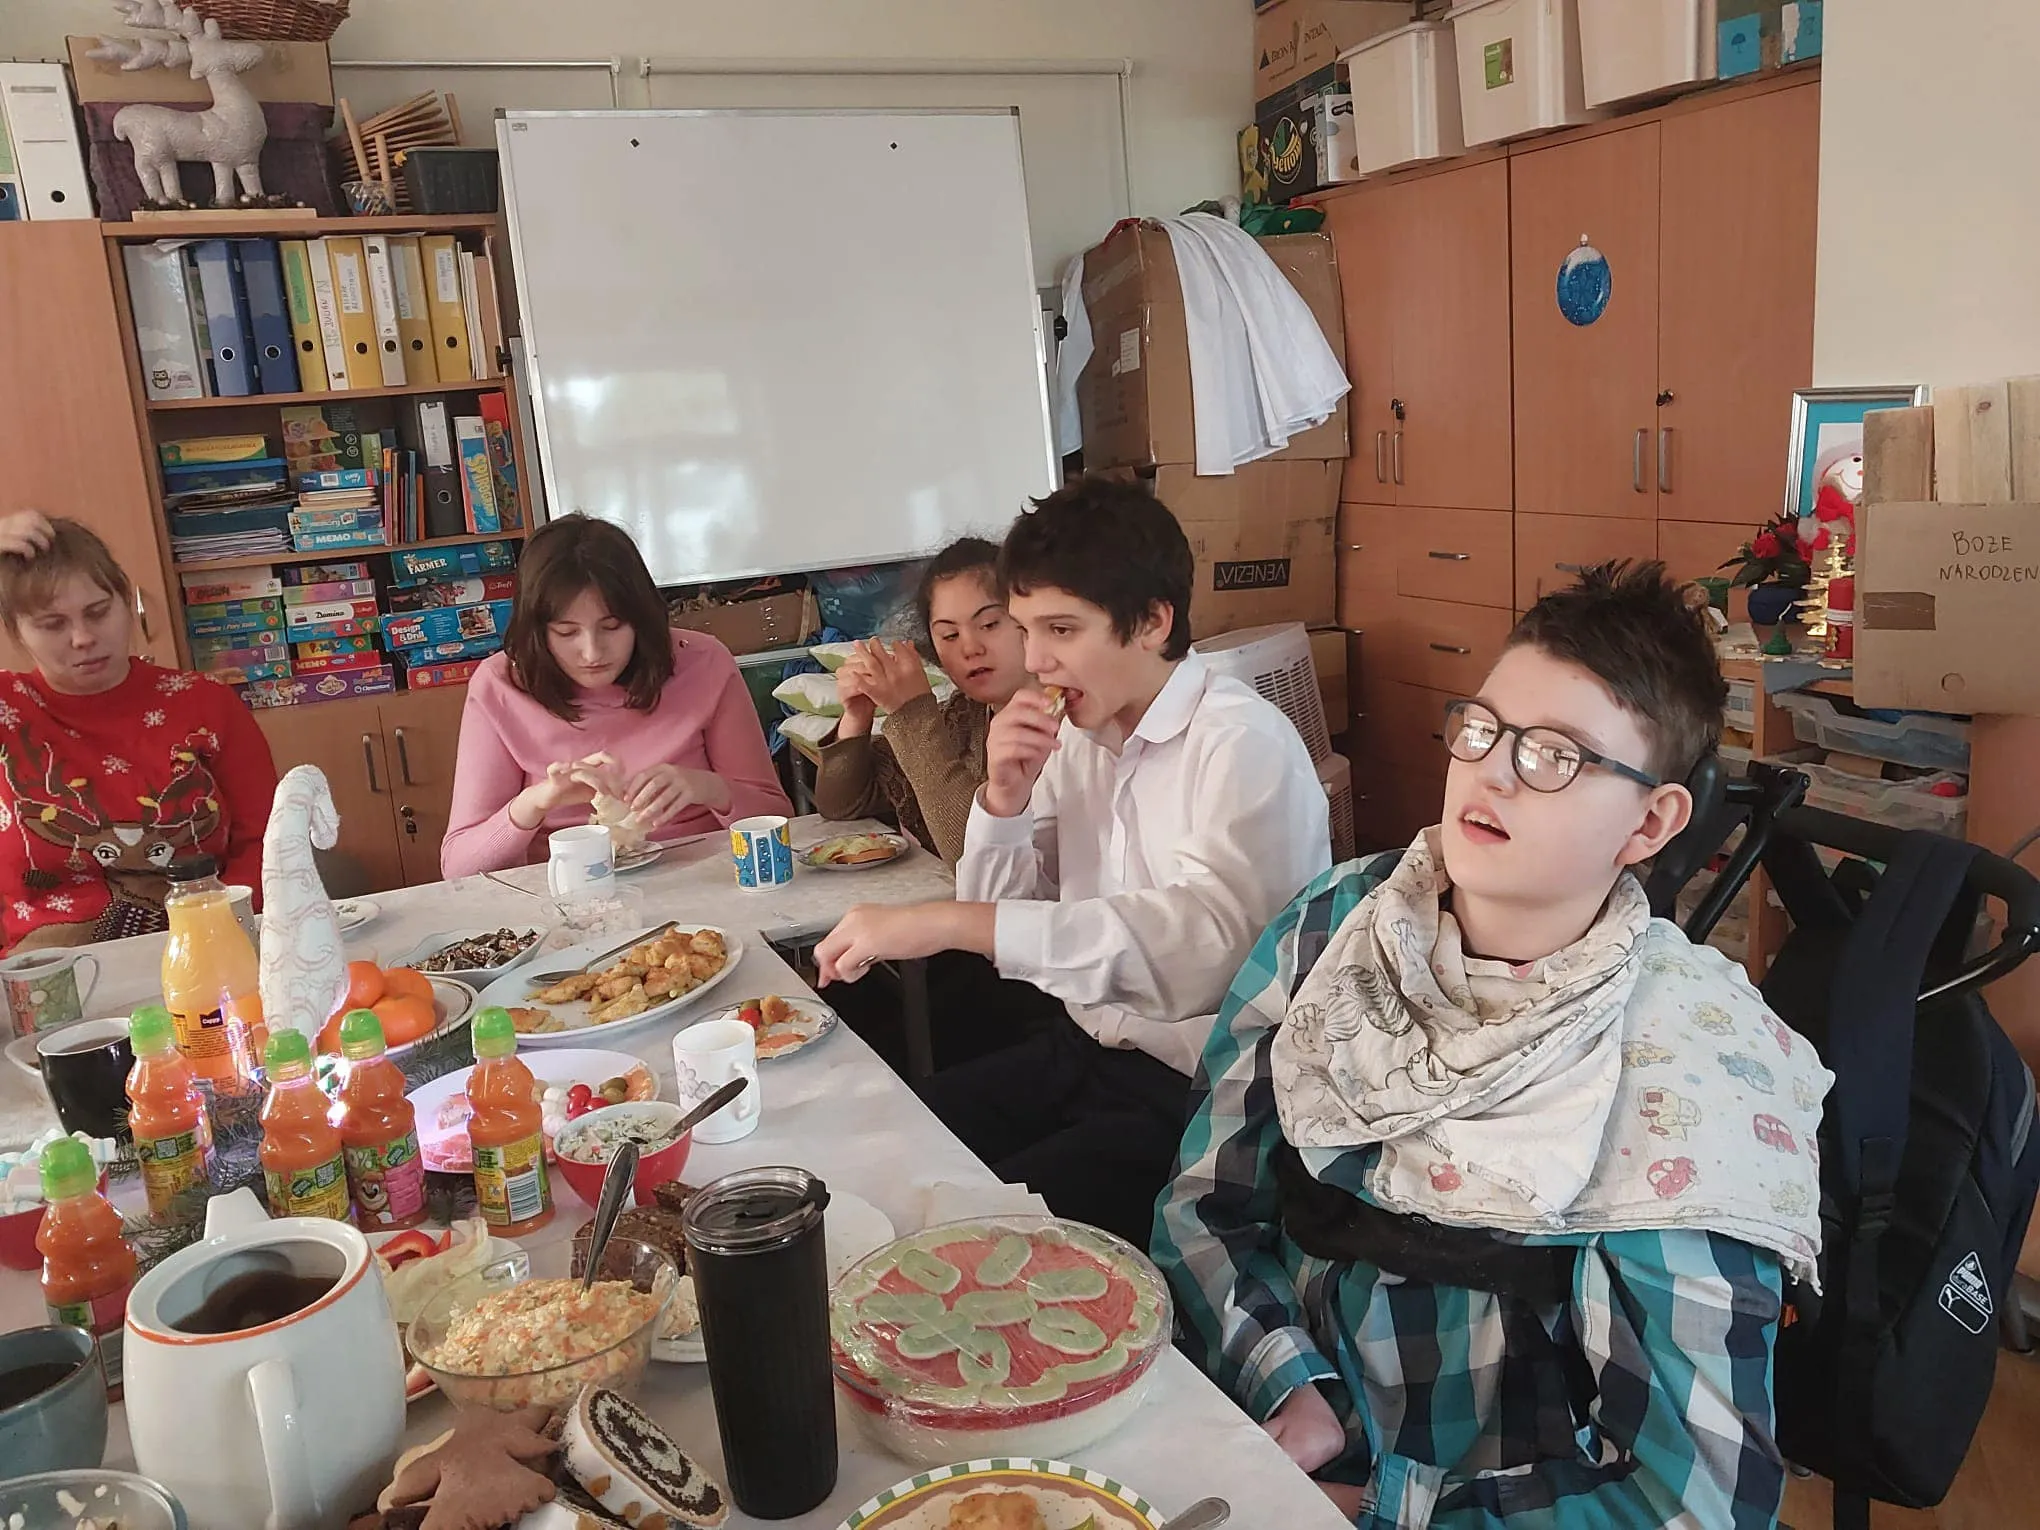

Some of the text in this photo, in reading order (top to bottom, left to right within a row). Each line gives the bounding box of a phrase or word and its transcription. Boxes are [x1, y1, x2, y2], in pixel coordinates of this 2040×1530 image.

[315, 533, 351, 544] MEMO
[407, 558, 447, 575] FARMER
[1220, 563, 1287, 584] VENEZIA
[391, 624, 421, 636] Design
